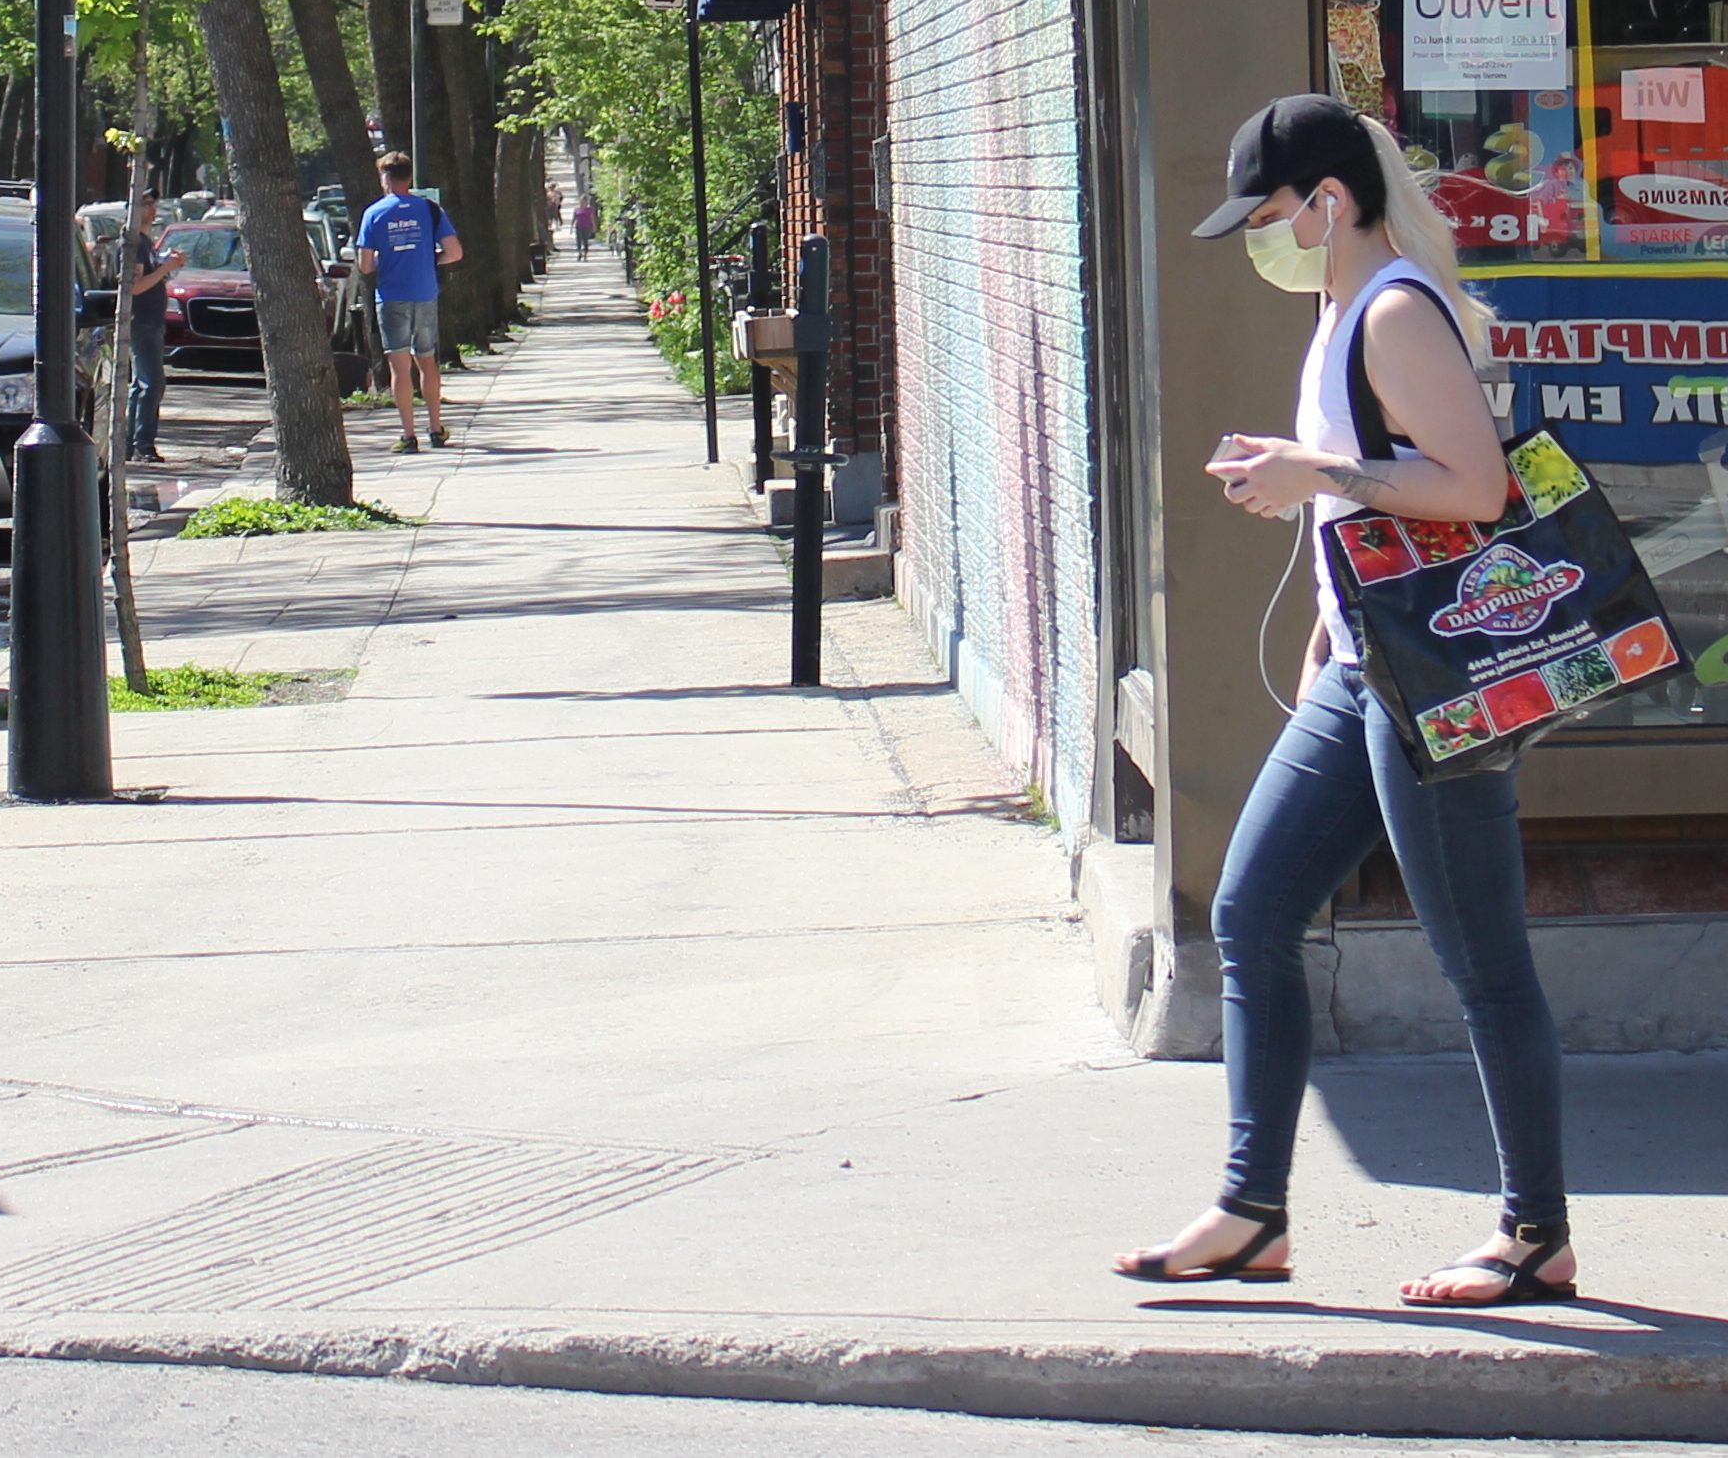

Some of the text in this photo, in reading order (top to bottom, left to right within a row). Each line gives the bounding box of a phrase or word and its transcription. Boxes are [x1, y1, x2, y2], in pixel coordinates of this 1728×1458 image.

[1413, 35, 1428, 44] Du
[1428, 34, 1454, 45] lundi
[1455, 37, 1468, 45] au
[1469, 34, 1504, 45] samedi
[1511, 34, 1529, 45] 10h
[1629, 226, 1693, 243] STARKE
[1446, 570, 1569, 630] DAUPHINAIS
